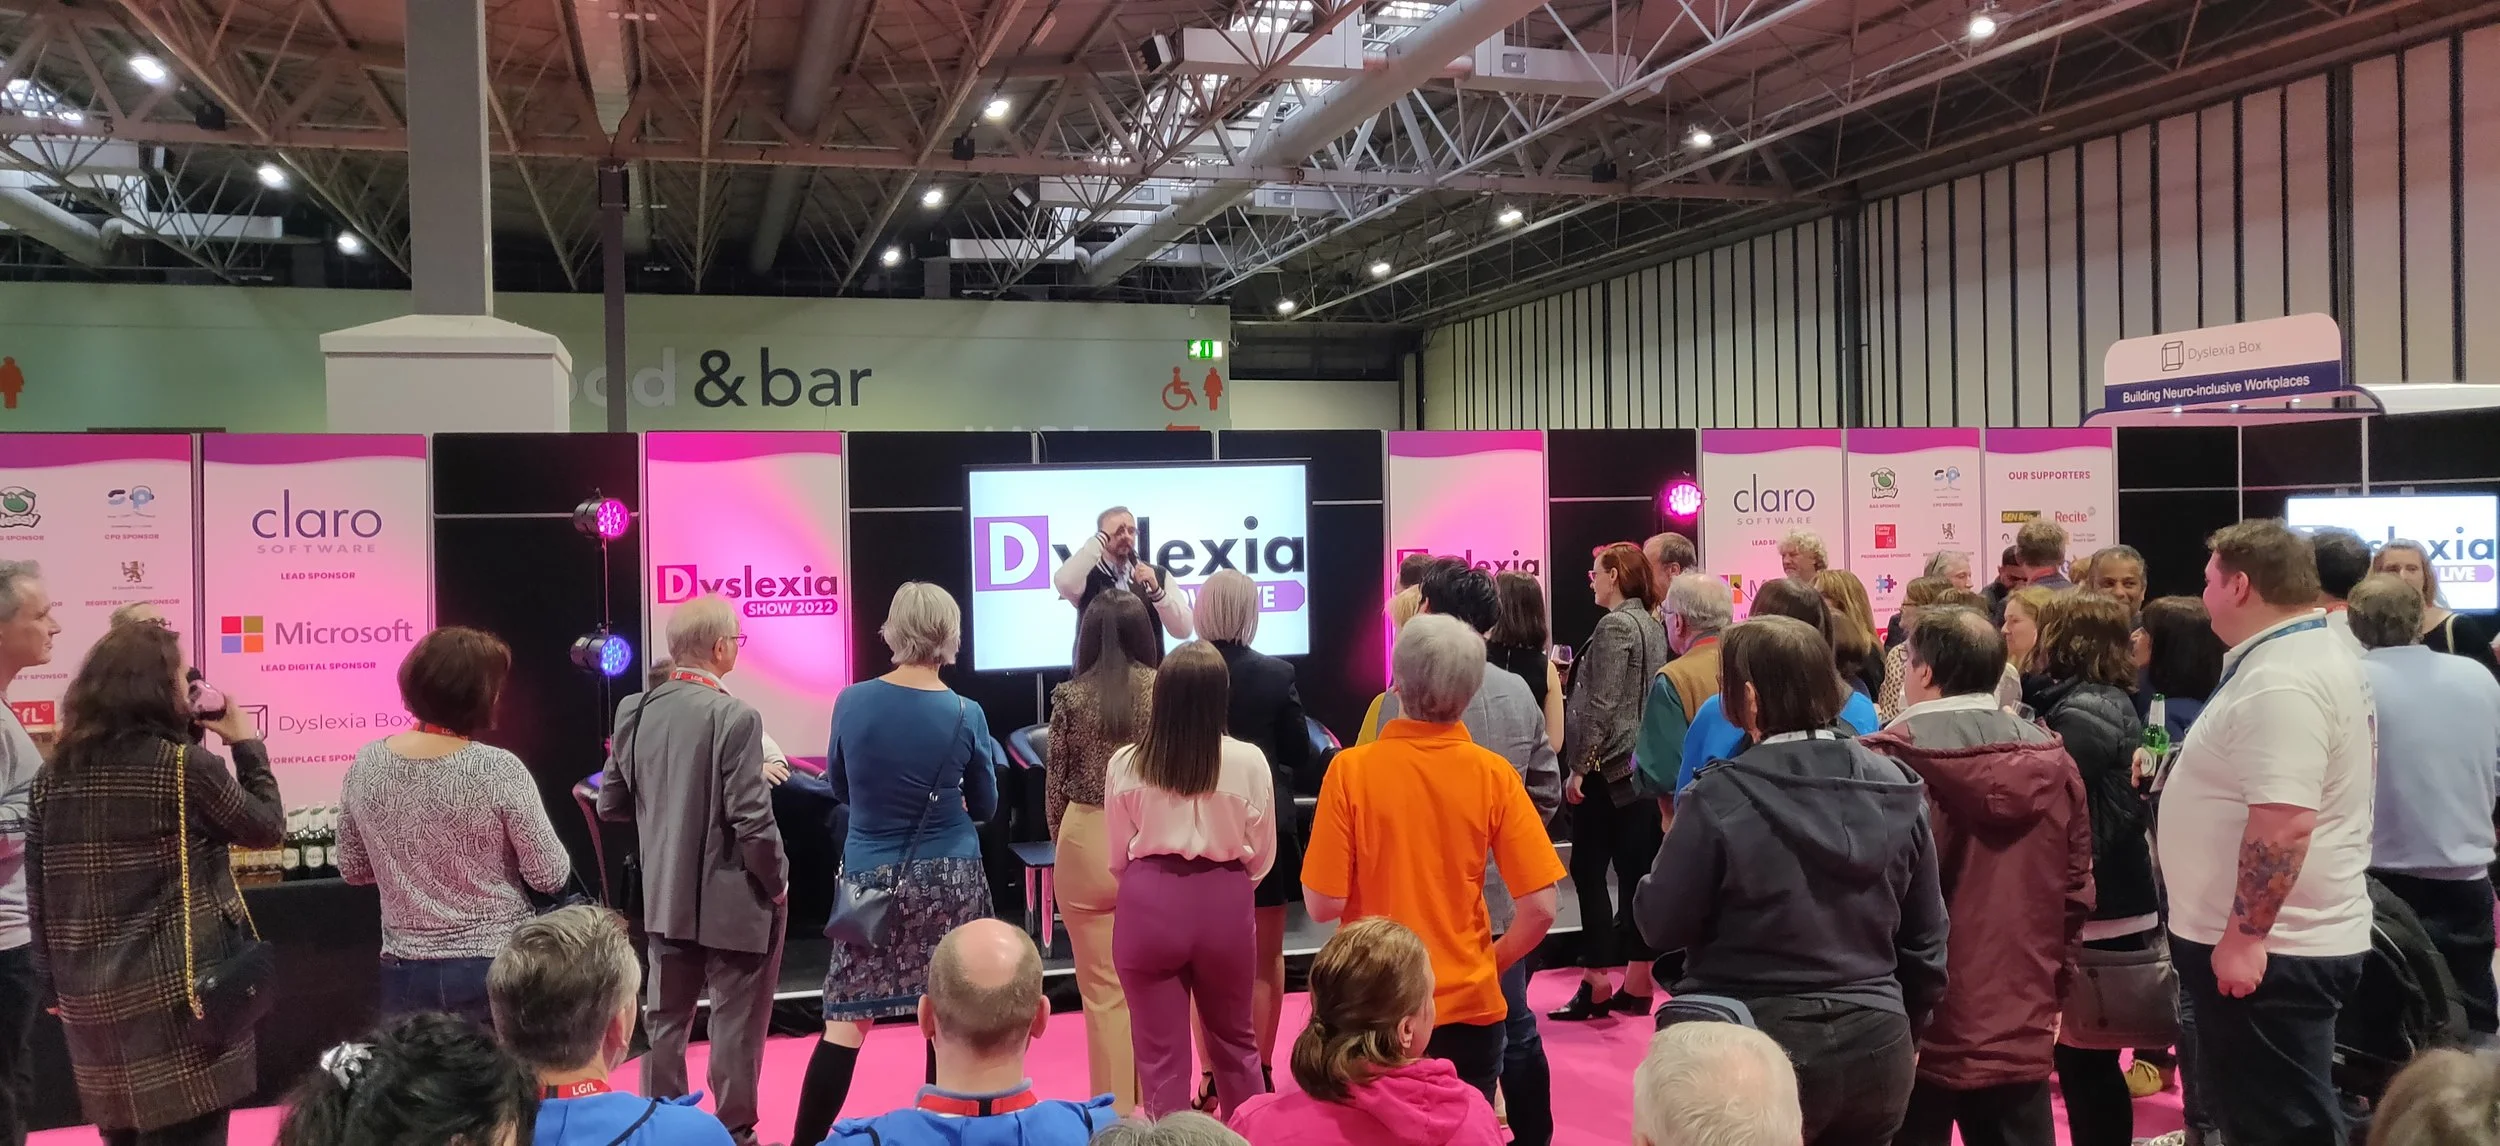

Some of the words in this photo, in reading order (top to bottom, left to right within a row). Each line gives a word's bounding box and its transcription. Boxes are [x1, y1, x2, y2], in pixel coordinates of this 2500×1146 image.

[2188, 345, 2235, 361] Dyslexia
[2239, 341, 2262, 353] Box
[694, 350, 748, 407] &
[760, 347, 872, 407] bar
[2123, 390, 2160, 404] Building
[2163, 382, 2242, 400] Neuro-inclusive
[2244, 374, 2310, 391] Workplaces
[2008, 471, 2029, 480] OUR
[2031, 470, 2091, 480] SUPPORTERS
[1733, 473, 1815, 513] claro
[252, 489, 382, 538] claro
[1737, 516, 1812, 526] SOFTWARE
[2055, 510, 2088, 523] Recite
[257, 544, 376, 554] SOFTWARE
[281, 572, 306, 580] LEAD
[308, 571, 356, 580] SPONSOR
[2439, 566, 2476, 582] LIVE
[749, 602, 792, 616] SHOW
[795, 601, 834, 614] 2022
[275, 619, 413, 645] Microsoft
[261, 664, 286, 672] LEAD
[288, 663, 328, 671] DIGITAL
[329, 662, 376, 670] SPONSOR
[279, 713, 366, 734] Dyslexia
[375, 712, 413, 728] Box
[329, 754, 356, 763] SPON
